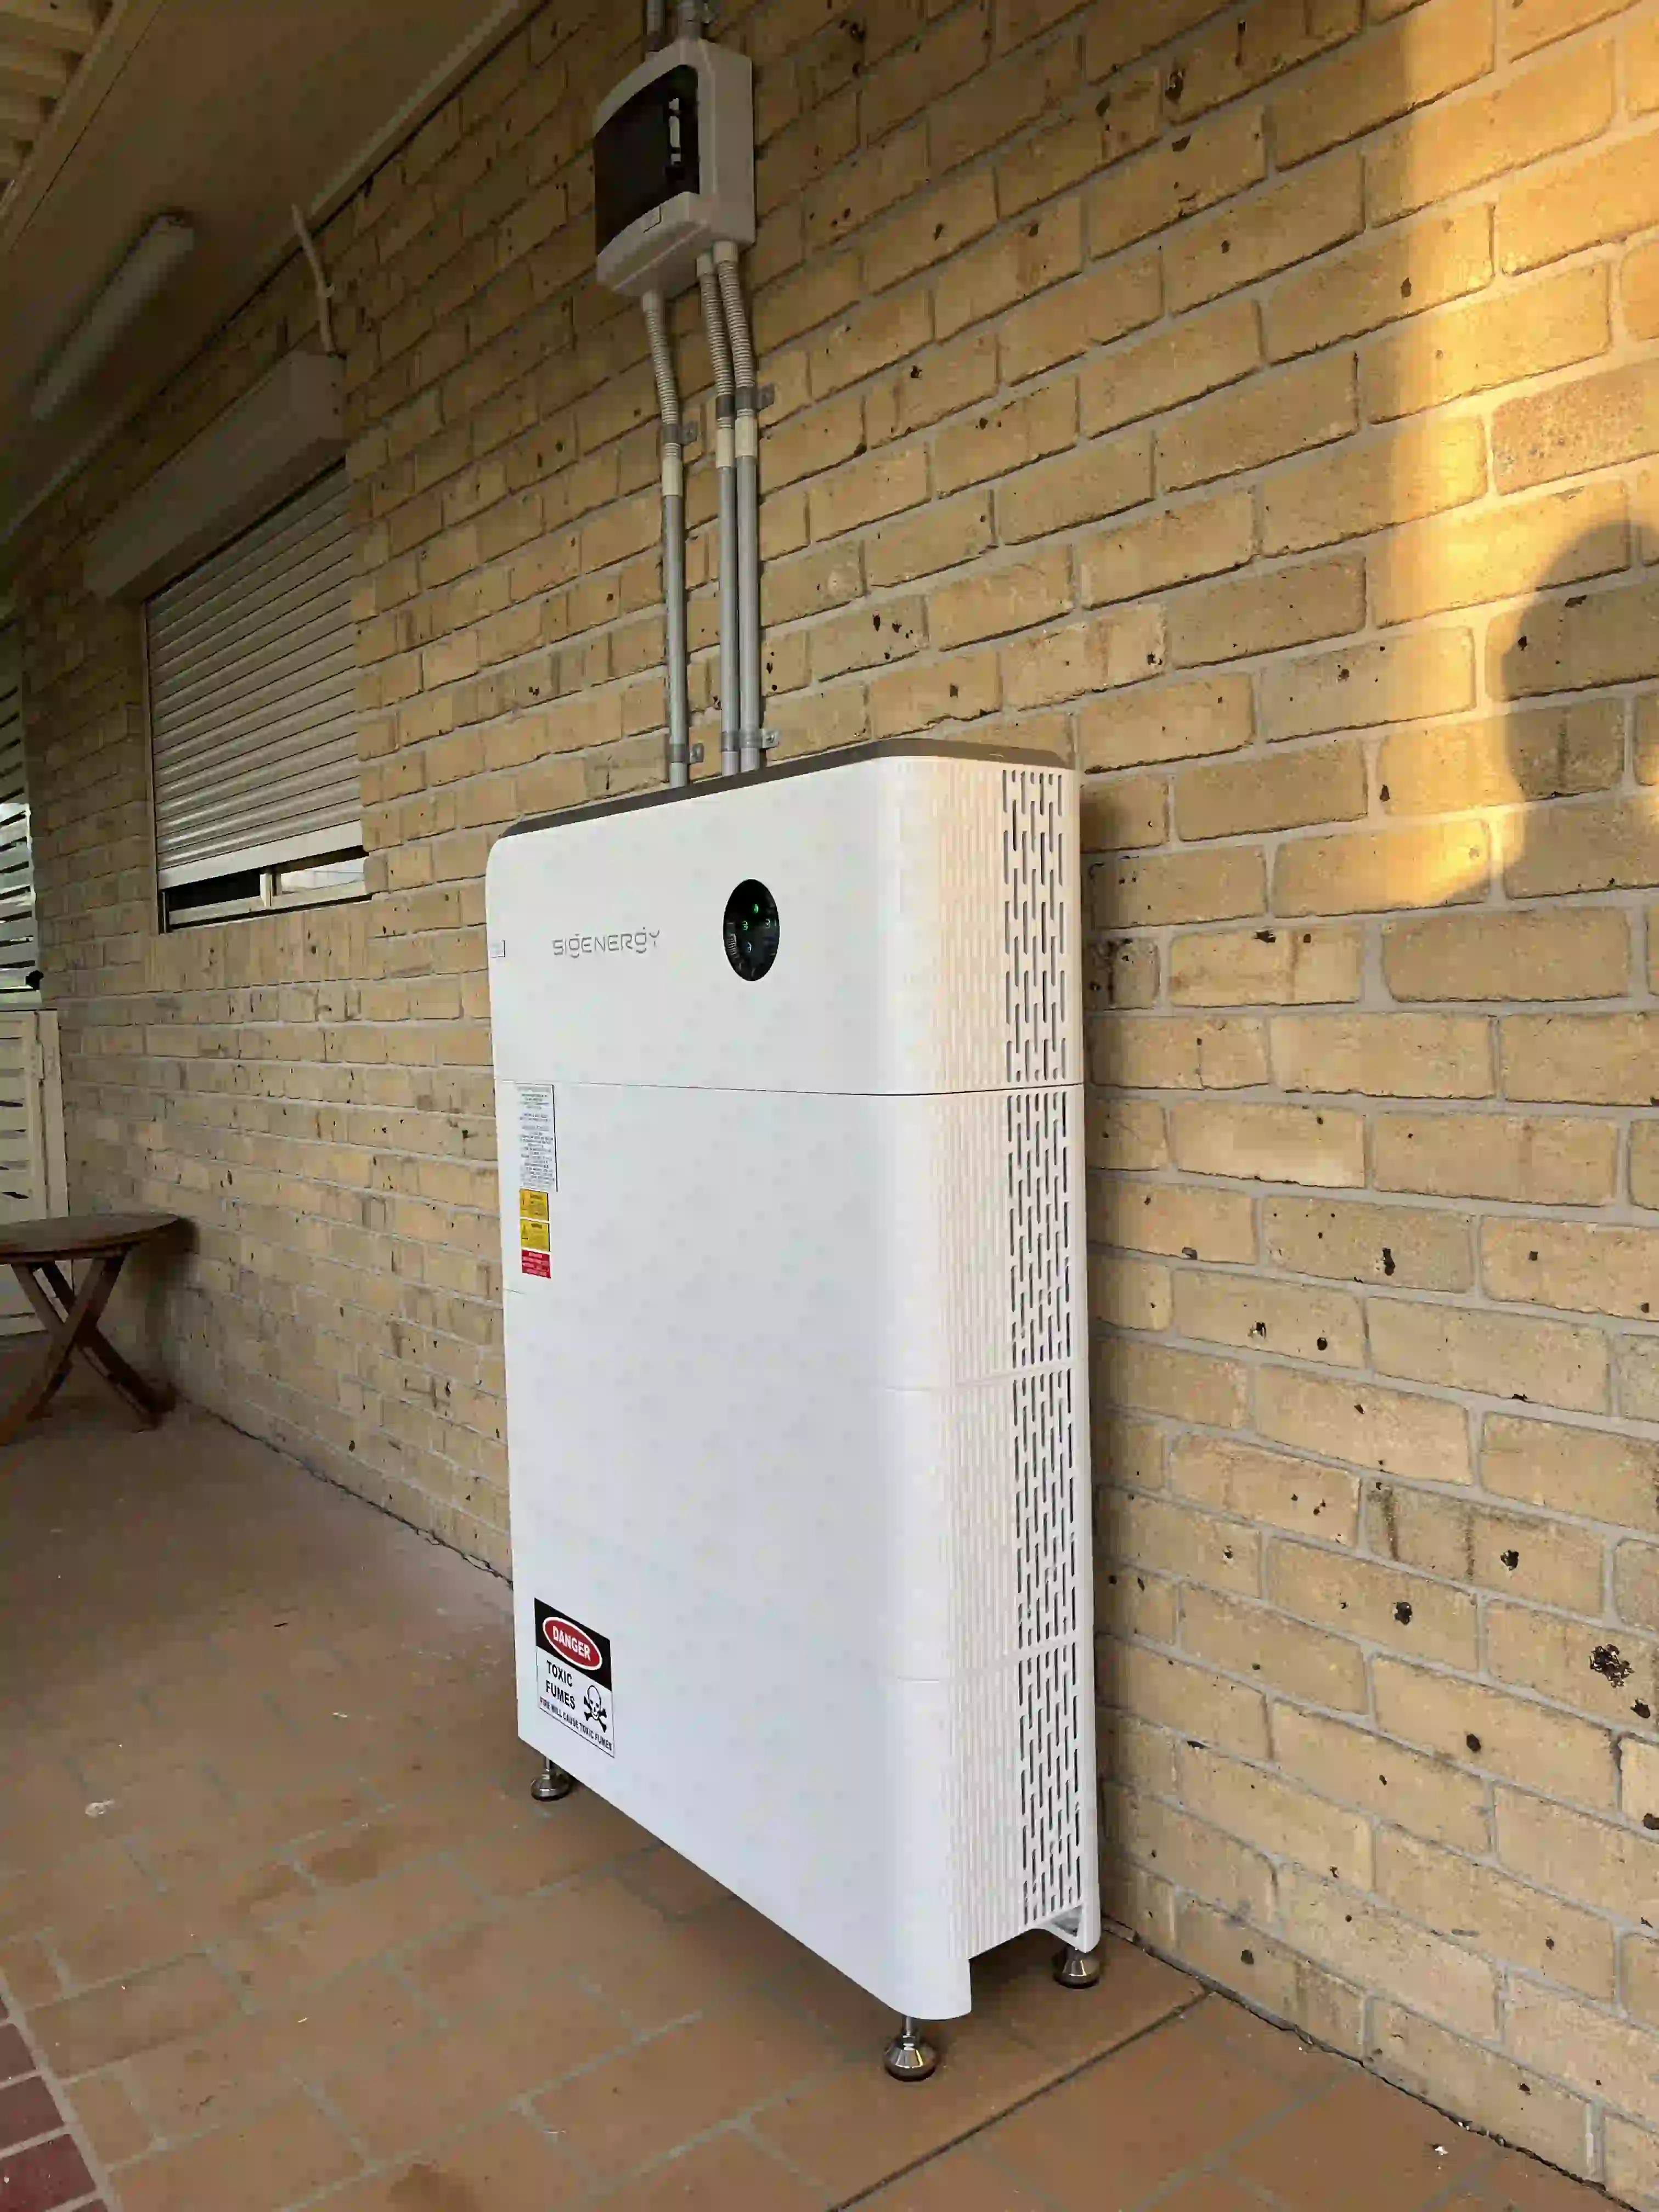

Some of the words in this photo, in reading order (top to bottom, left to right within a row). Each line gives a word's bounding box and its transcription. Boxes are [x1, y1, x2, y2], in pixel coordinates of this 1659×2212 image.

[551, 926, 660, 958] SIGENERGY
[552, 1626, 591, 1661] DANGER
[546, 1660, 573, 1688] TOXIC
[546, 1680, 575, 1710] FUMES
[540, 1696, 550, 1711] FIRE
[551, 1705, 562, 1719] WILL
[563, 1711, 578, 1729] CAUSE
[579, 1722, 594, 1739] TOXIC
[595, 1731, 612, 1752] FUMES
